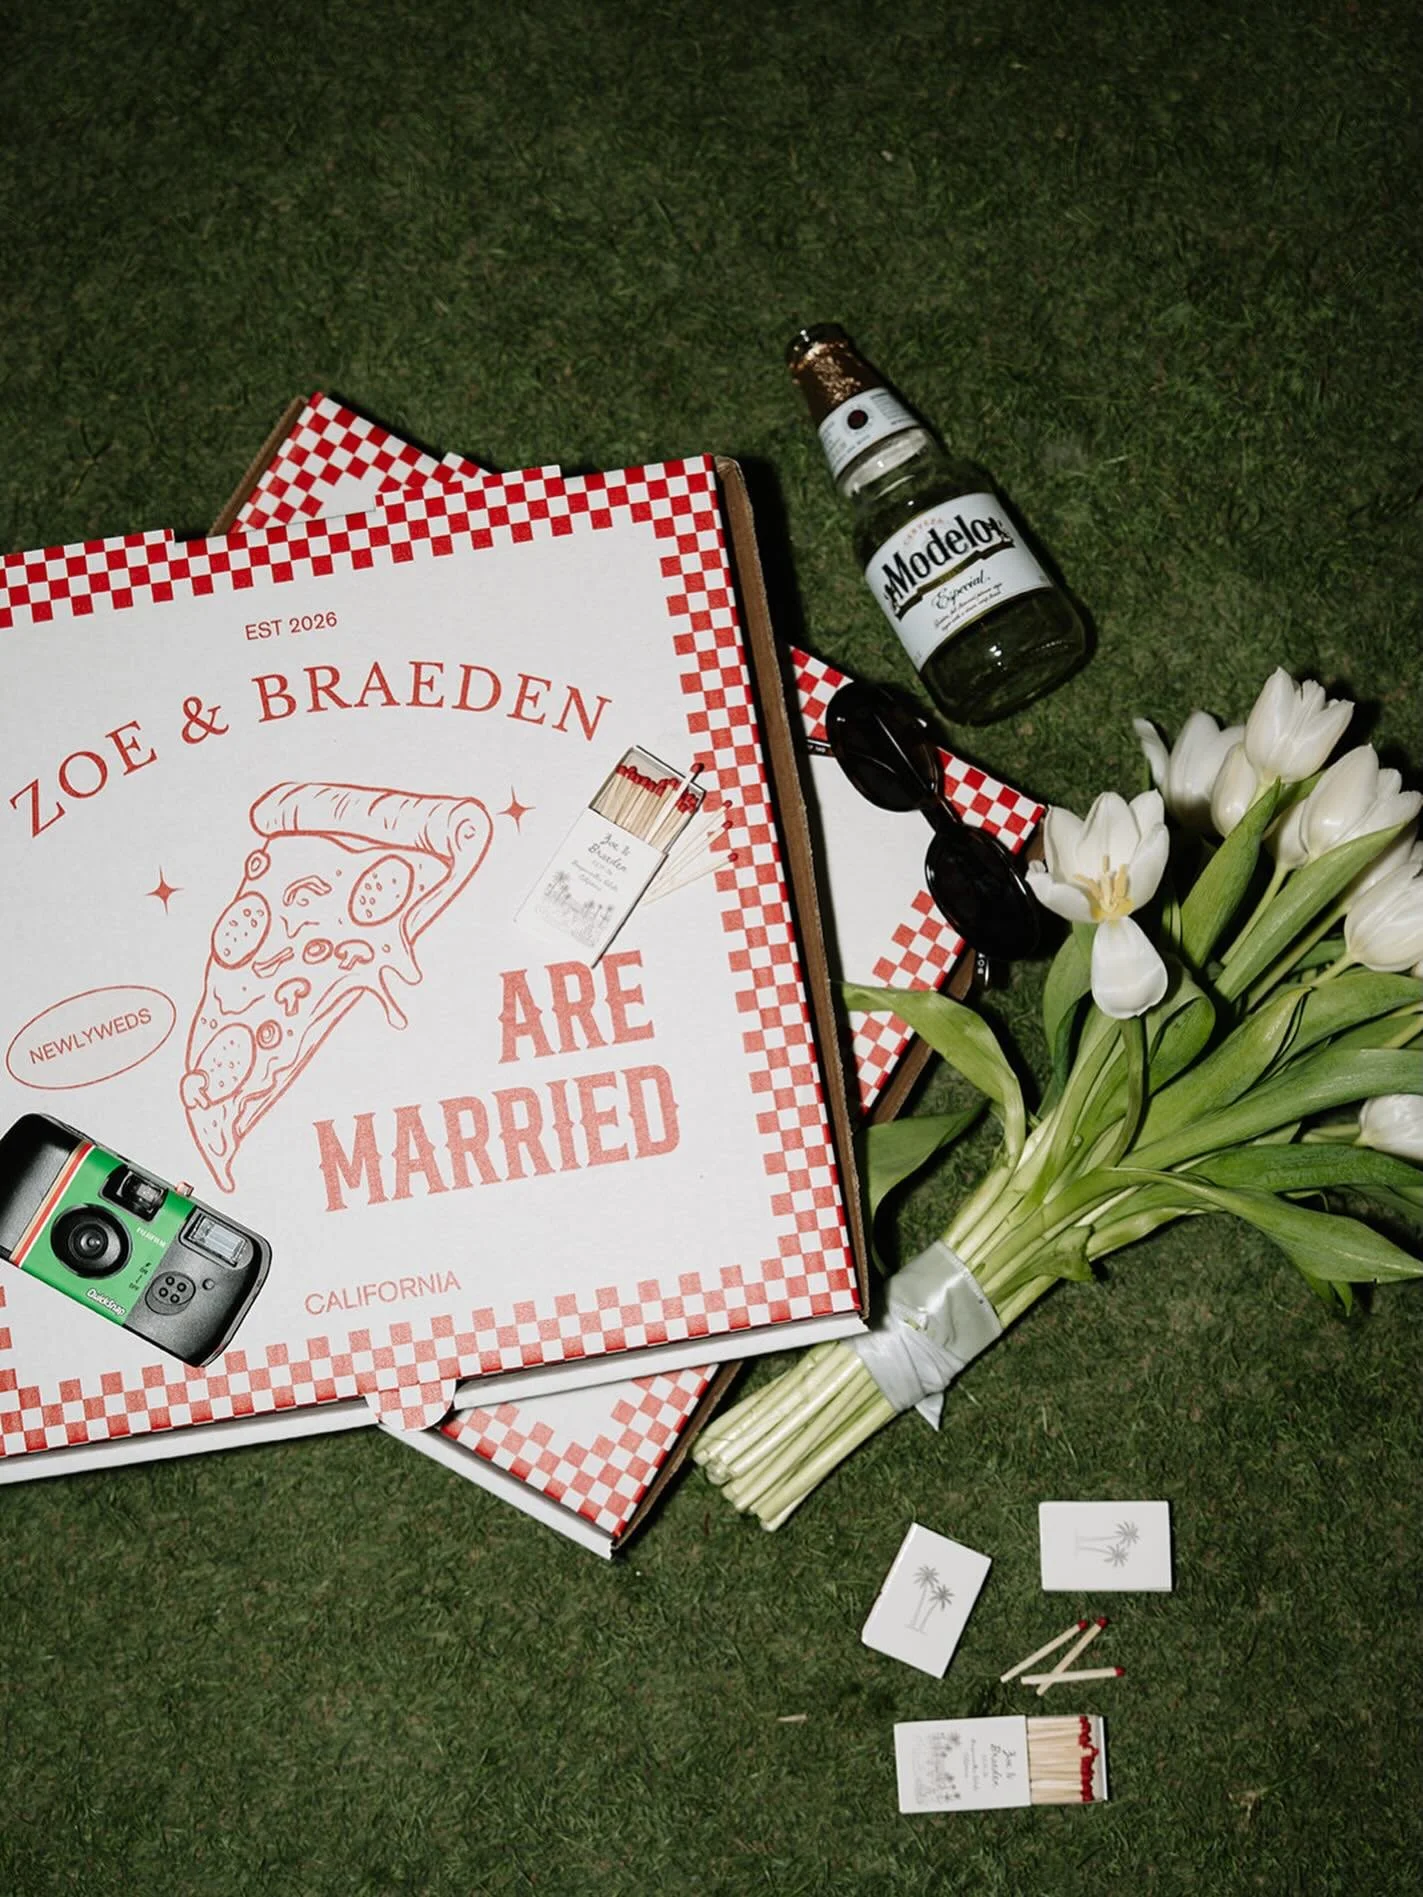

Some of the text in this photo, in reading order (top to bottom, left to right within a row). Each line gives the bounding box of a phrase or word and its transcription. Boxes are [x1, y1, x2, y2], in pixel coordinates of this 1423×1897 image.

[882, 514, 996, 600] Modelo
[245, 611, 337, 641] EST 2026
[9, 661, 612, 838] ZOE & BRAEDEN
[29, 1007, 152, 1065] NEWLYWEDS
[499, 949, 655, 1063] ARE
[312, 1064, 681, 1212] MARRIED
[305, 1270, 462, 1316] CALIFORNIA
